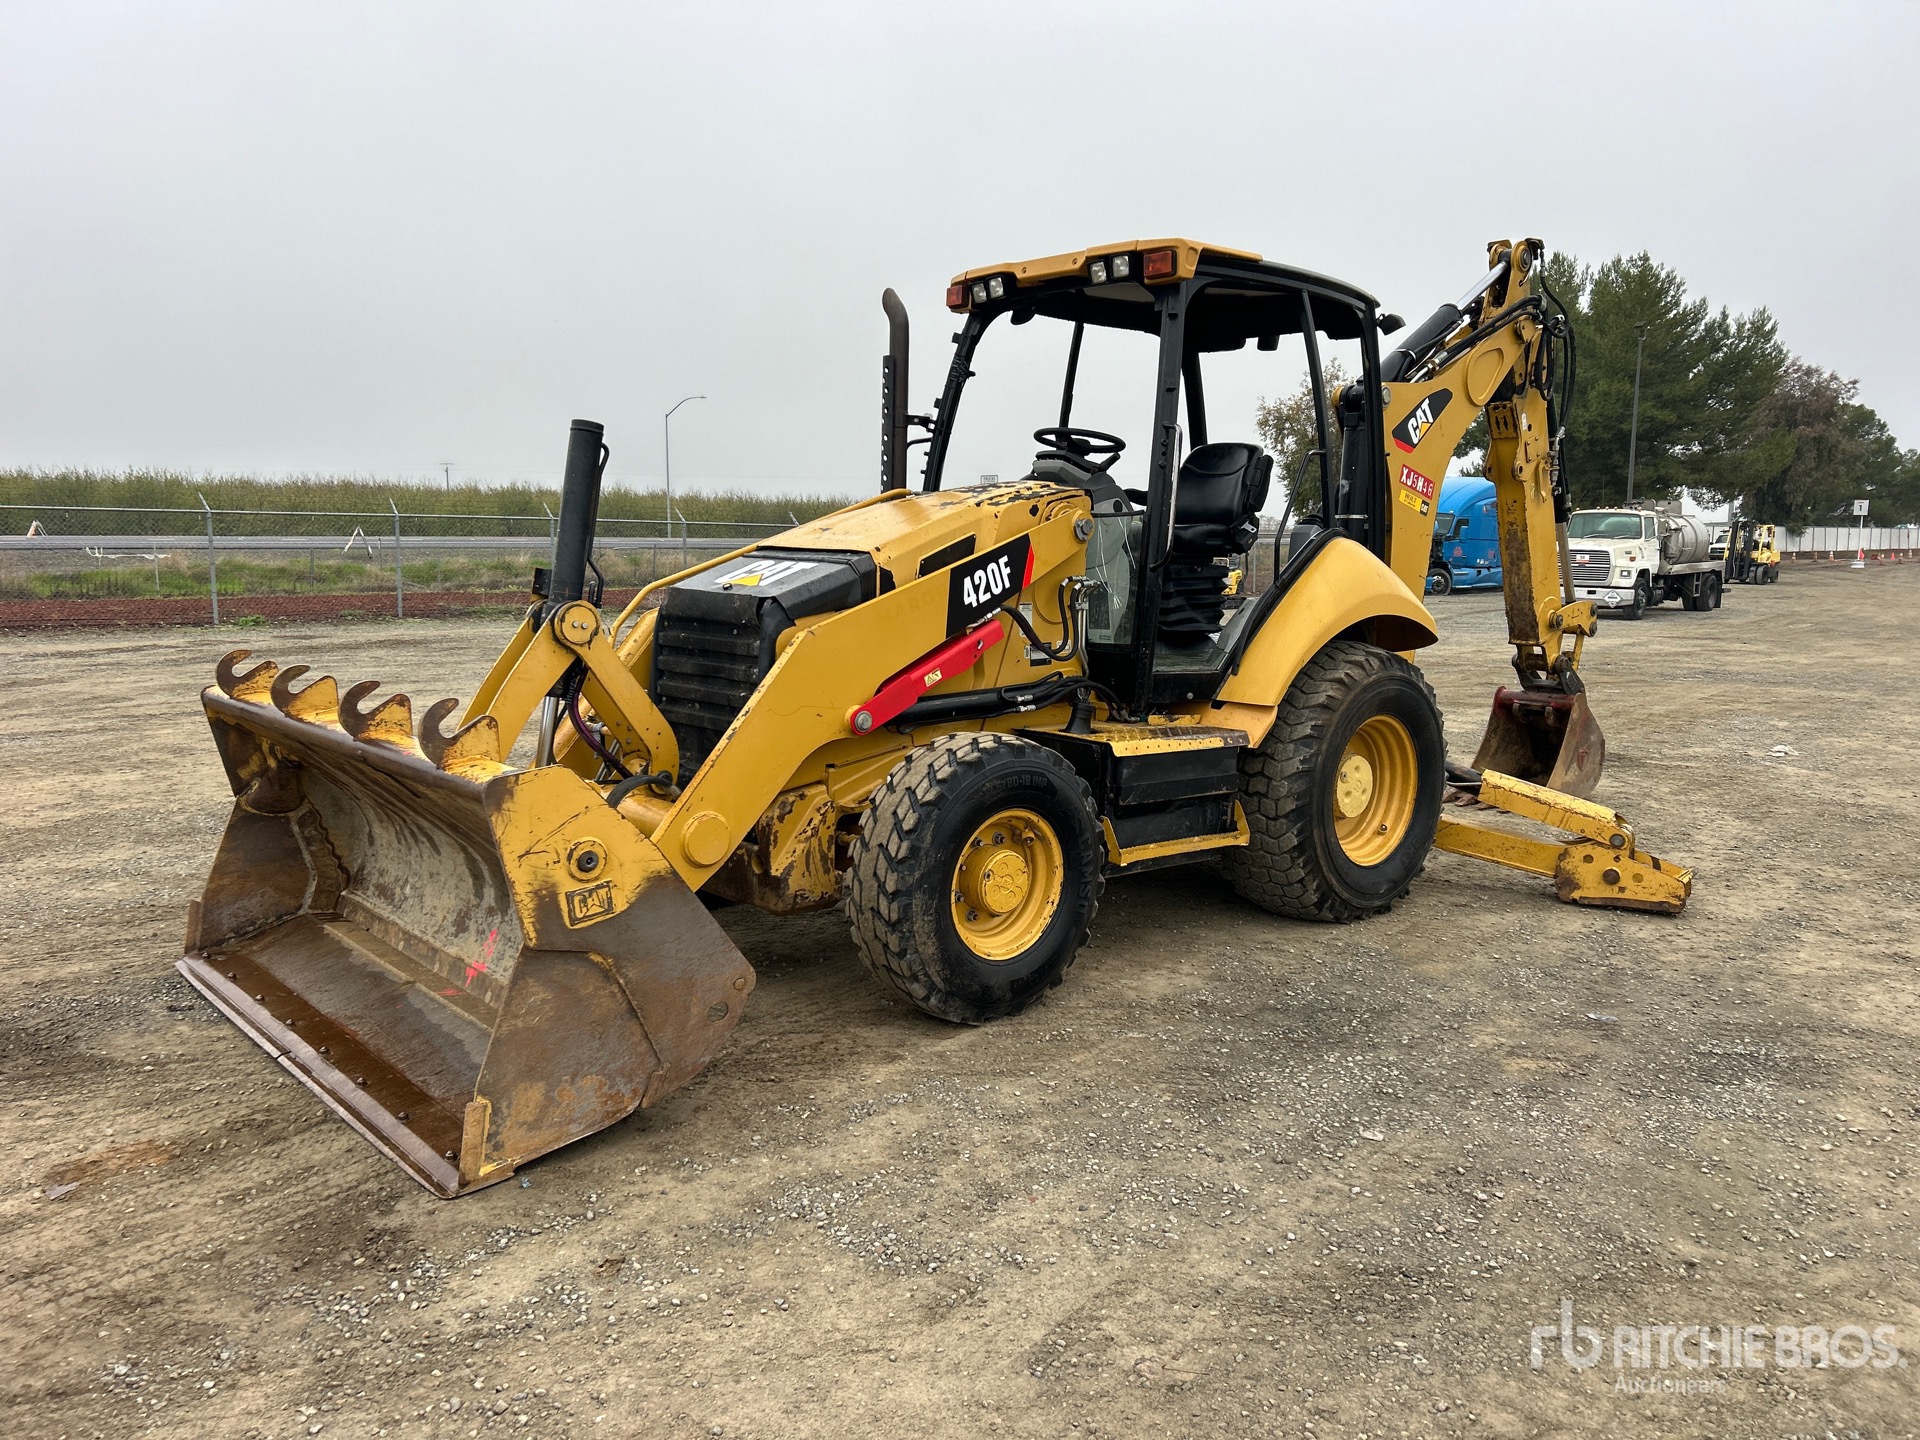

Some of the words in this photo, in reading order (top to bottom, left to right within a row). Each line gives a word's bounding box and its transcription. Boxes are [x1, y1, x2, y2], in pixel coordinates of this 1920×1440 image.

[1407, 397, 1434, 445] CAT
[714, 559, 819, 587] CAT
[963, 554, 1011, 608] 420F
[572, 885, 611, 918] CAT
